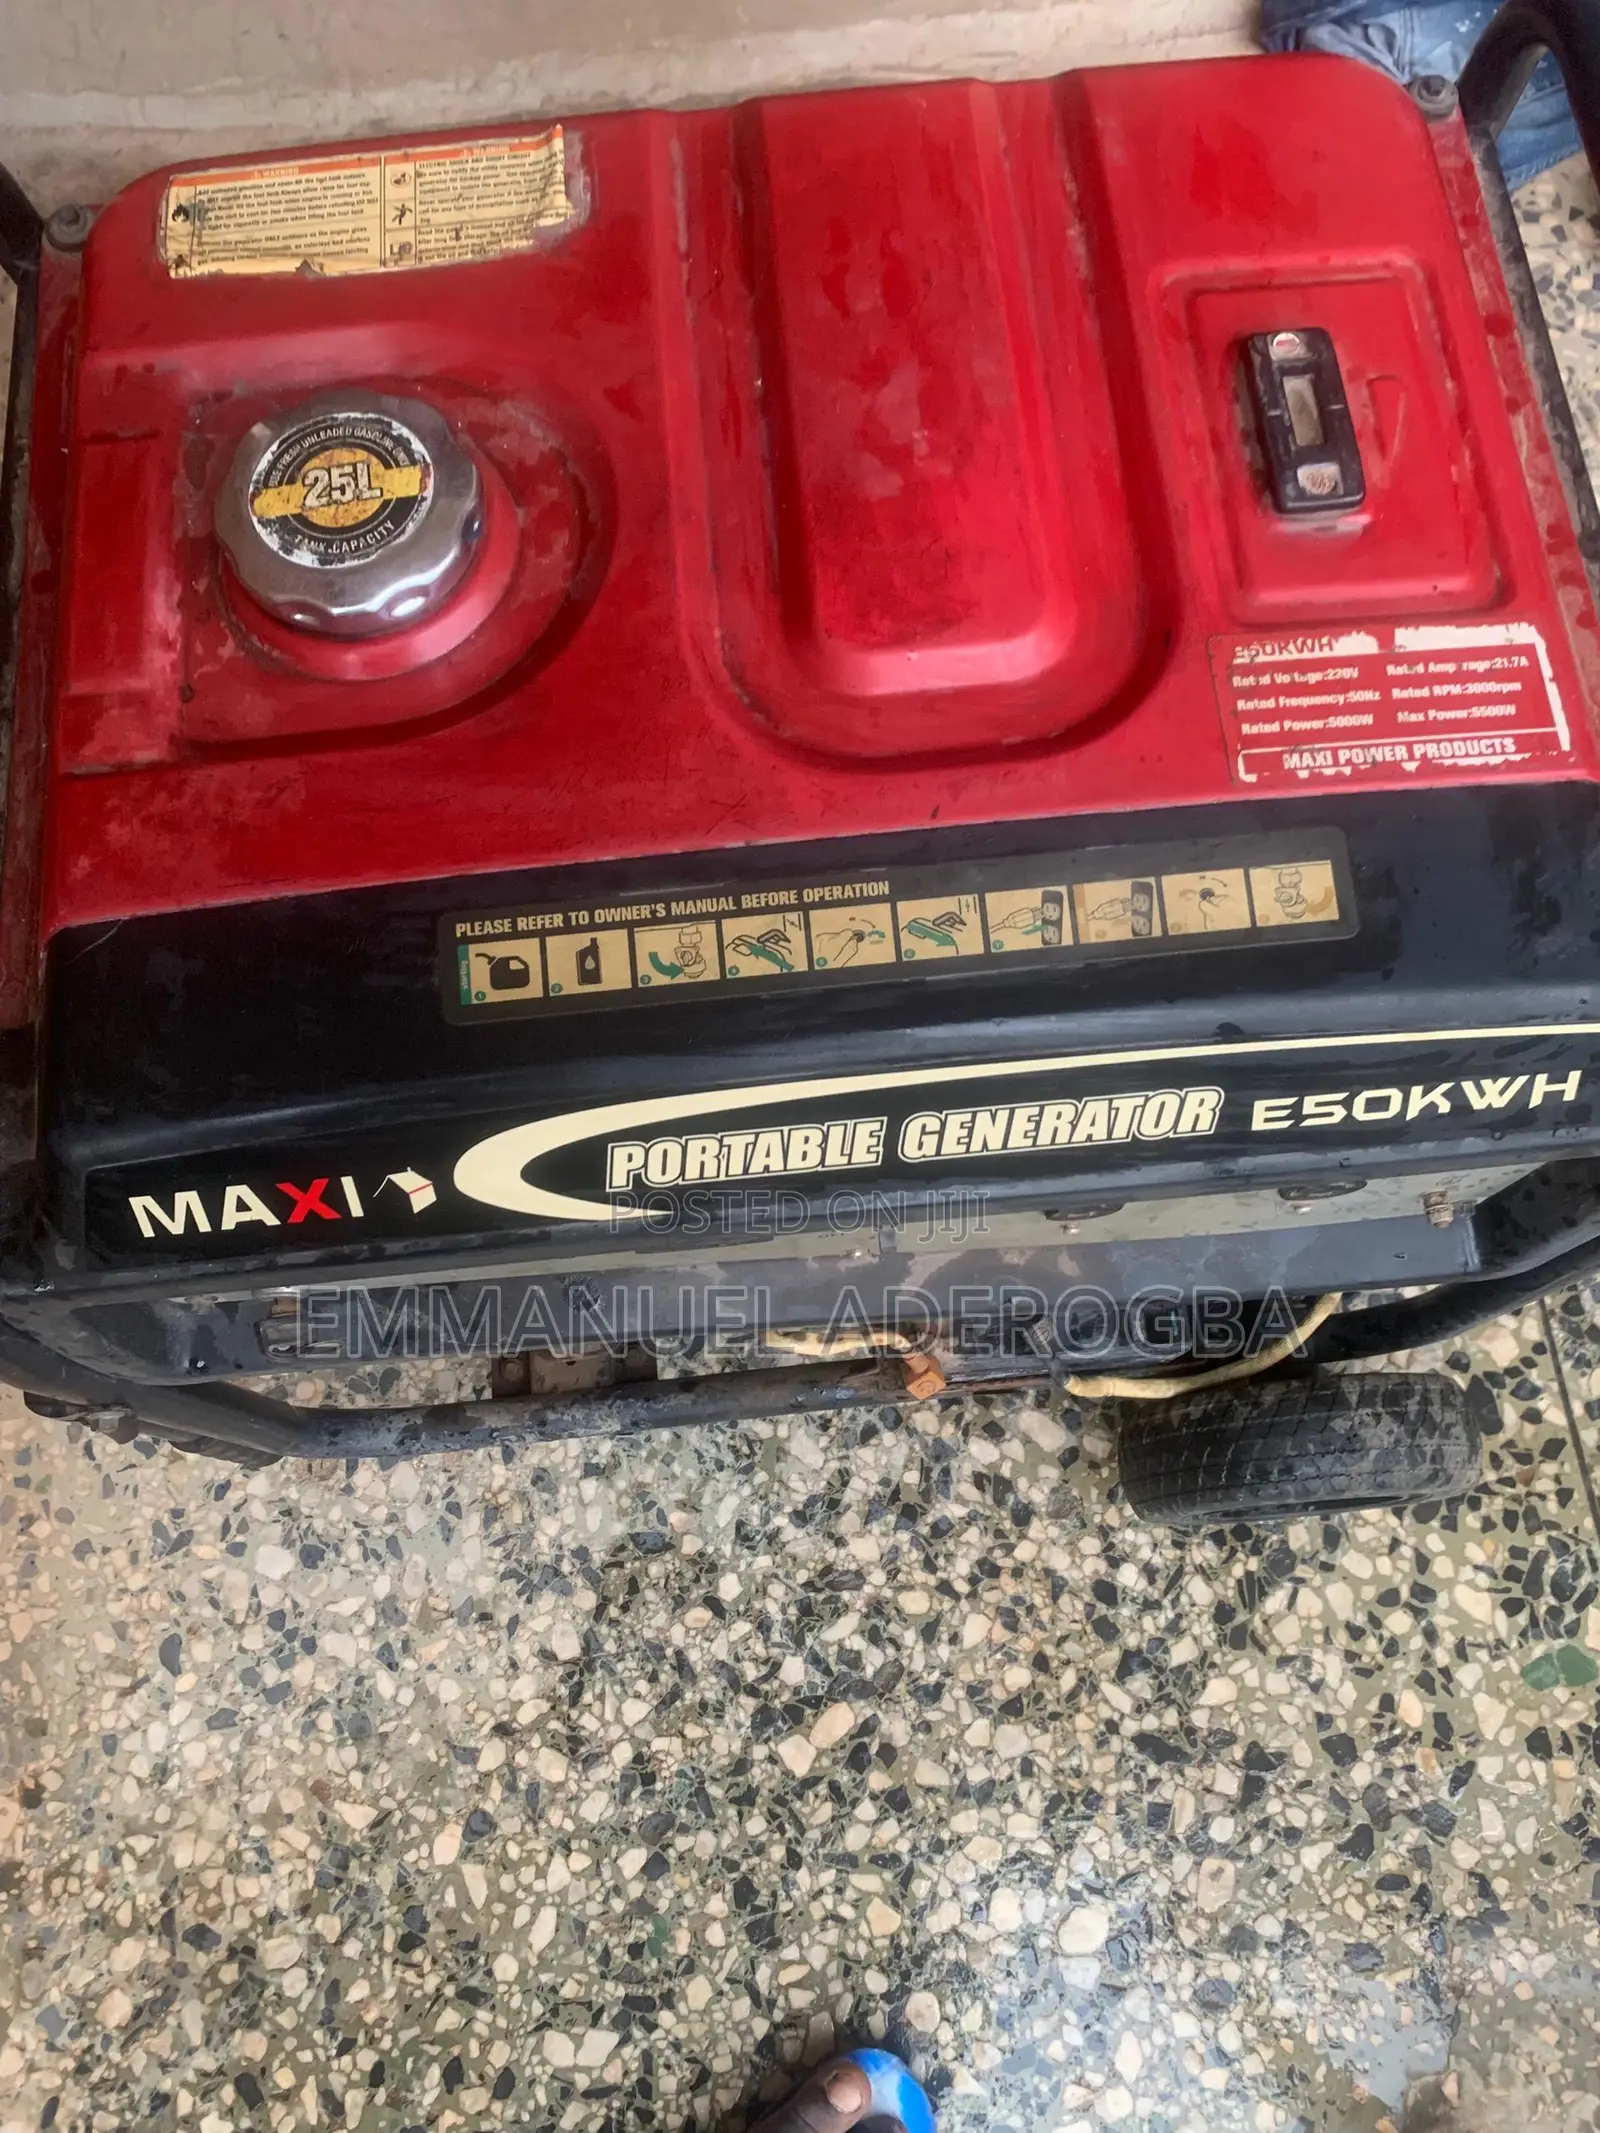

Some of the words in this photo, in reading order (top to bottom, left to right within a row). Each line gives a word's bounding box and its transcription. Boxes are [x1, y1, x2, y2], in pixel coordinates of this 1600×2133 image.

[278, 443, 302, 469] FRESH
[301, 426, 352, 449] UNLEADED
[354, 427, 395, 449] GASOLINE
[303, 462, 382, 509] 25L
[295, 535, 327, 553] TANK
[332, 520, 395, 553] CAPACITY
[1428, 656, 1529, 673] Amprage:21.7A
[1237, 696, 1275, 711] Rated
[1279, 689, 1381, 709] Frequency:50Hz
[1391, 685, 1430, 699] Rated
[1241, 720, 1280, 735] Rated
[1283, 713, 1374, 732] Power:5000W
[1397, 711, 1425, 723] Max
[1428, 704, 1516, 721] Power:5500W
[1282, 750, 1333, 770] MAXI
[1338, 743, 1409, 766] POWER
[1413, 737, 1517, 760] PRODUCTS
[455, 918, 513, 938] PLEASE
[517, 912, 564, 932] REFER
[567, 909, 590, 926] TO
[594, 902, 666, 923] OWNER'S
[670, 893, 738, 915] MANUAL
[741, 887, 799, 910] BEFORE
[803, 880, 890, 903] OPERATION
[1251, 1070, 1583, 1132] E50KWH
[605, 1116, 888, 1192] PORTABLE
[897, 1086, 1225, 1163] GENERATOR
[129, 1175, 364, 1238] MAXI
